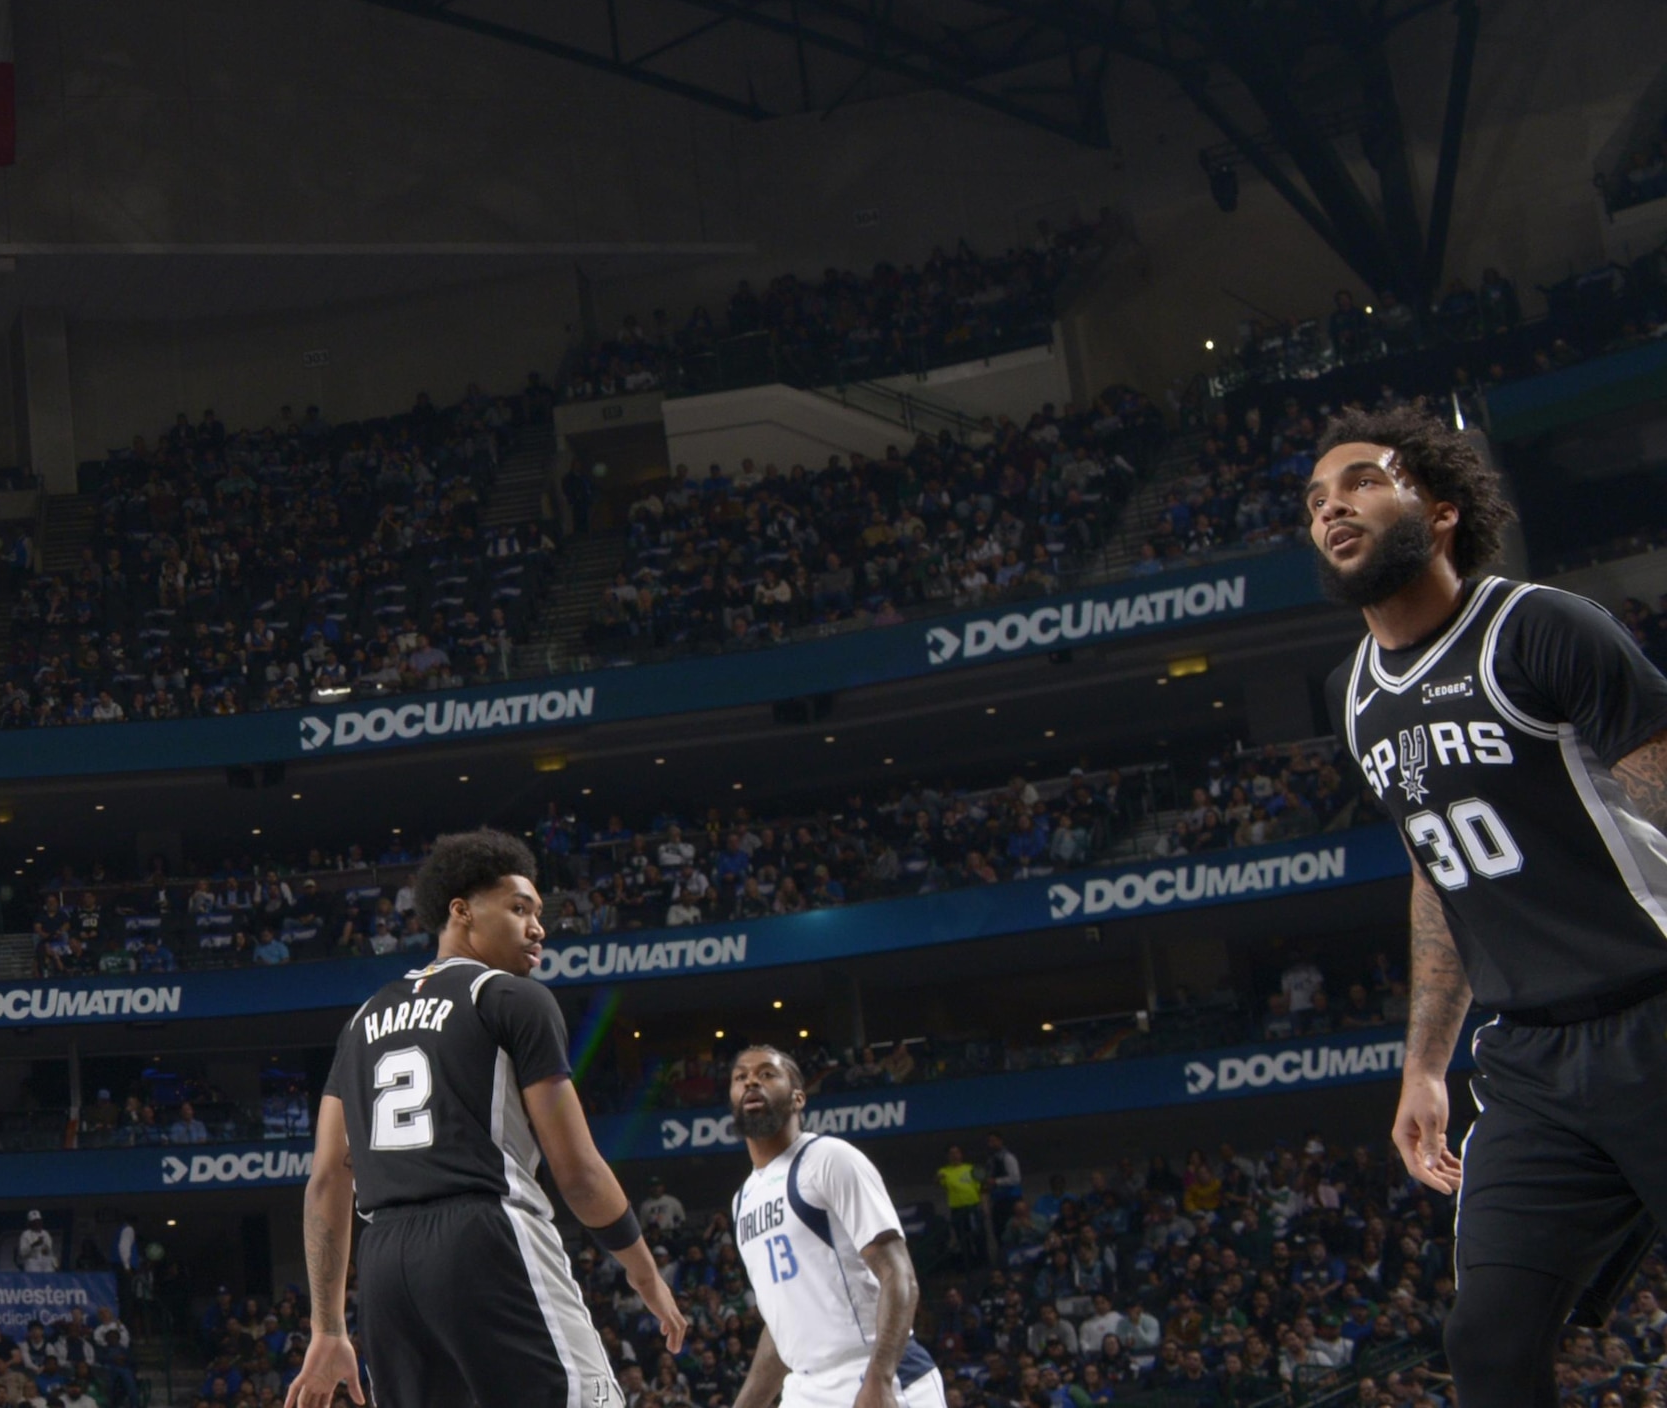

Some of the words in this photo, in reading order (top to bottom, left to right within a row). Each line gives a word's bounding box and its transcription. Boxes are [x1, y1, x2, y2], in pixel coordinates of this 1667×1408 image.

[962, 573, 1247, 659] DOCUMATION
[333, 683, 597, 748] DOCUMATION
[1428, 682, 1467, 698] LEDGER
[1405, 797, 1524, 891] 30
[1082, 845, 1346, 917] DOCUMATION
[364, 998, 453, 1044] HARPER
[369, 1046, 434, 1151] 2
[739, 1197, 784, 1245] DALLAS
[764, 1233, 799, 1284] 13
